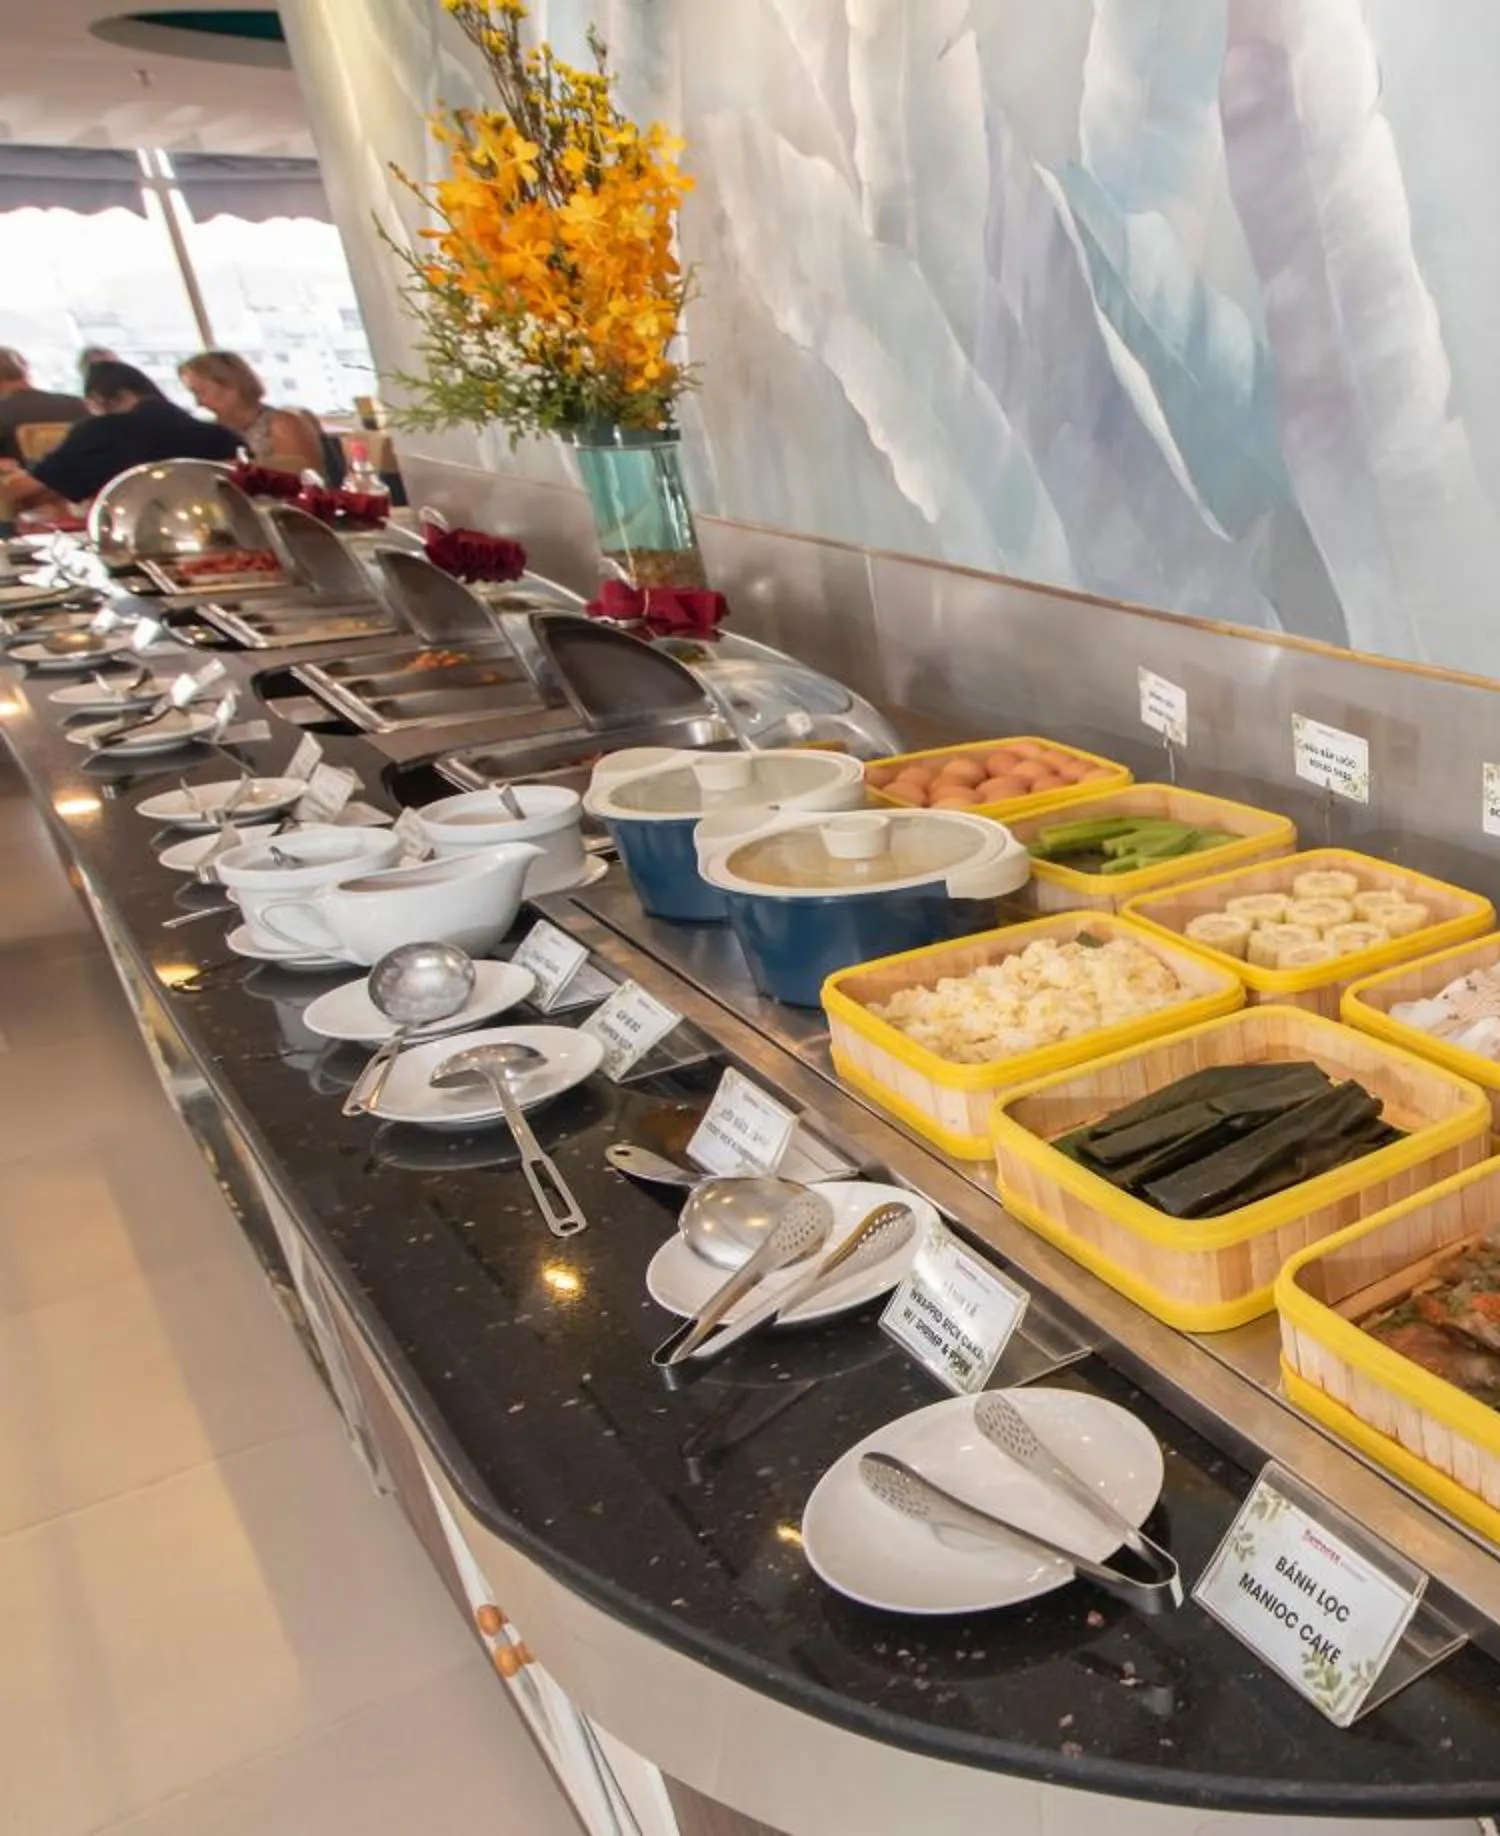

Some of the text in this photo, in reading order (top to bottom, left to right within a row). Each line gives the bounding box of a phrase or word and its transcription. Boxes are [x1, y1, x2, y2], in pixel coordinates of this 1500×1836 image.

[1238, 1572, 1342, 1666] MANIOC CAKE
[1275, 1554, 1318, 1597] BÁNH
[1317, 1588, 1351, 1624] LỌC
